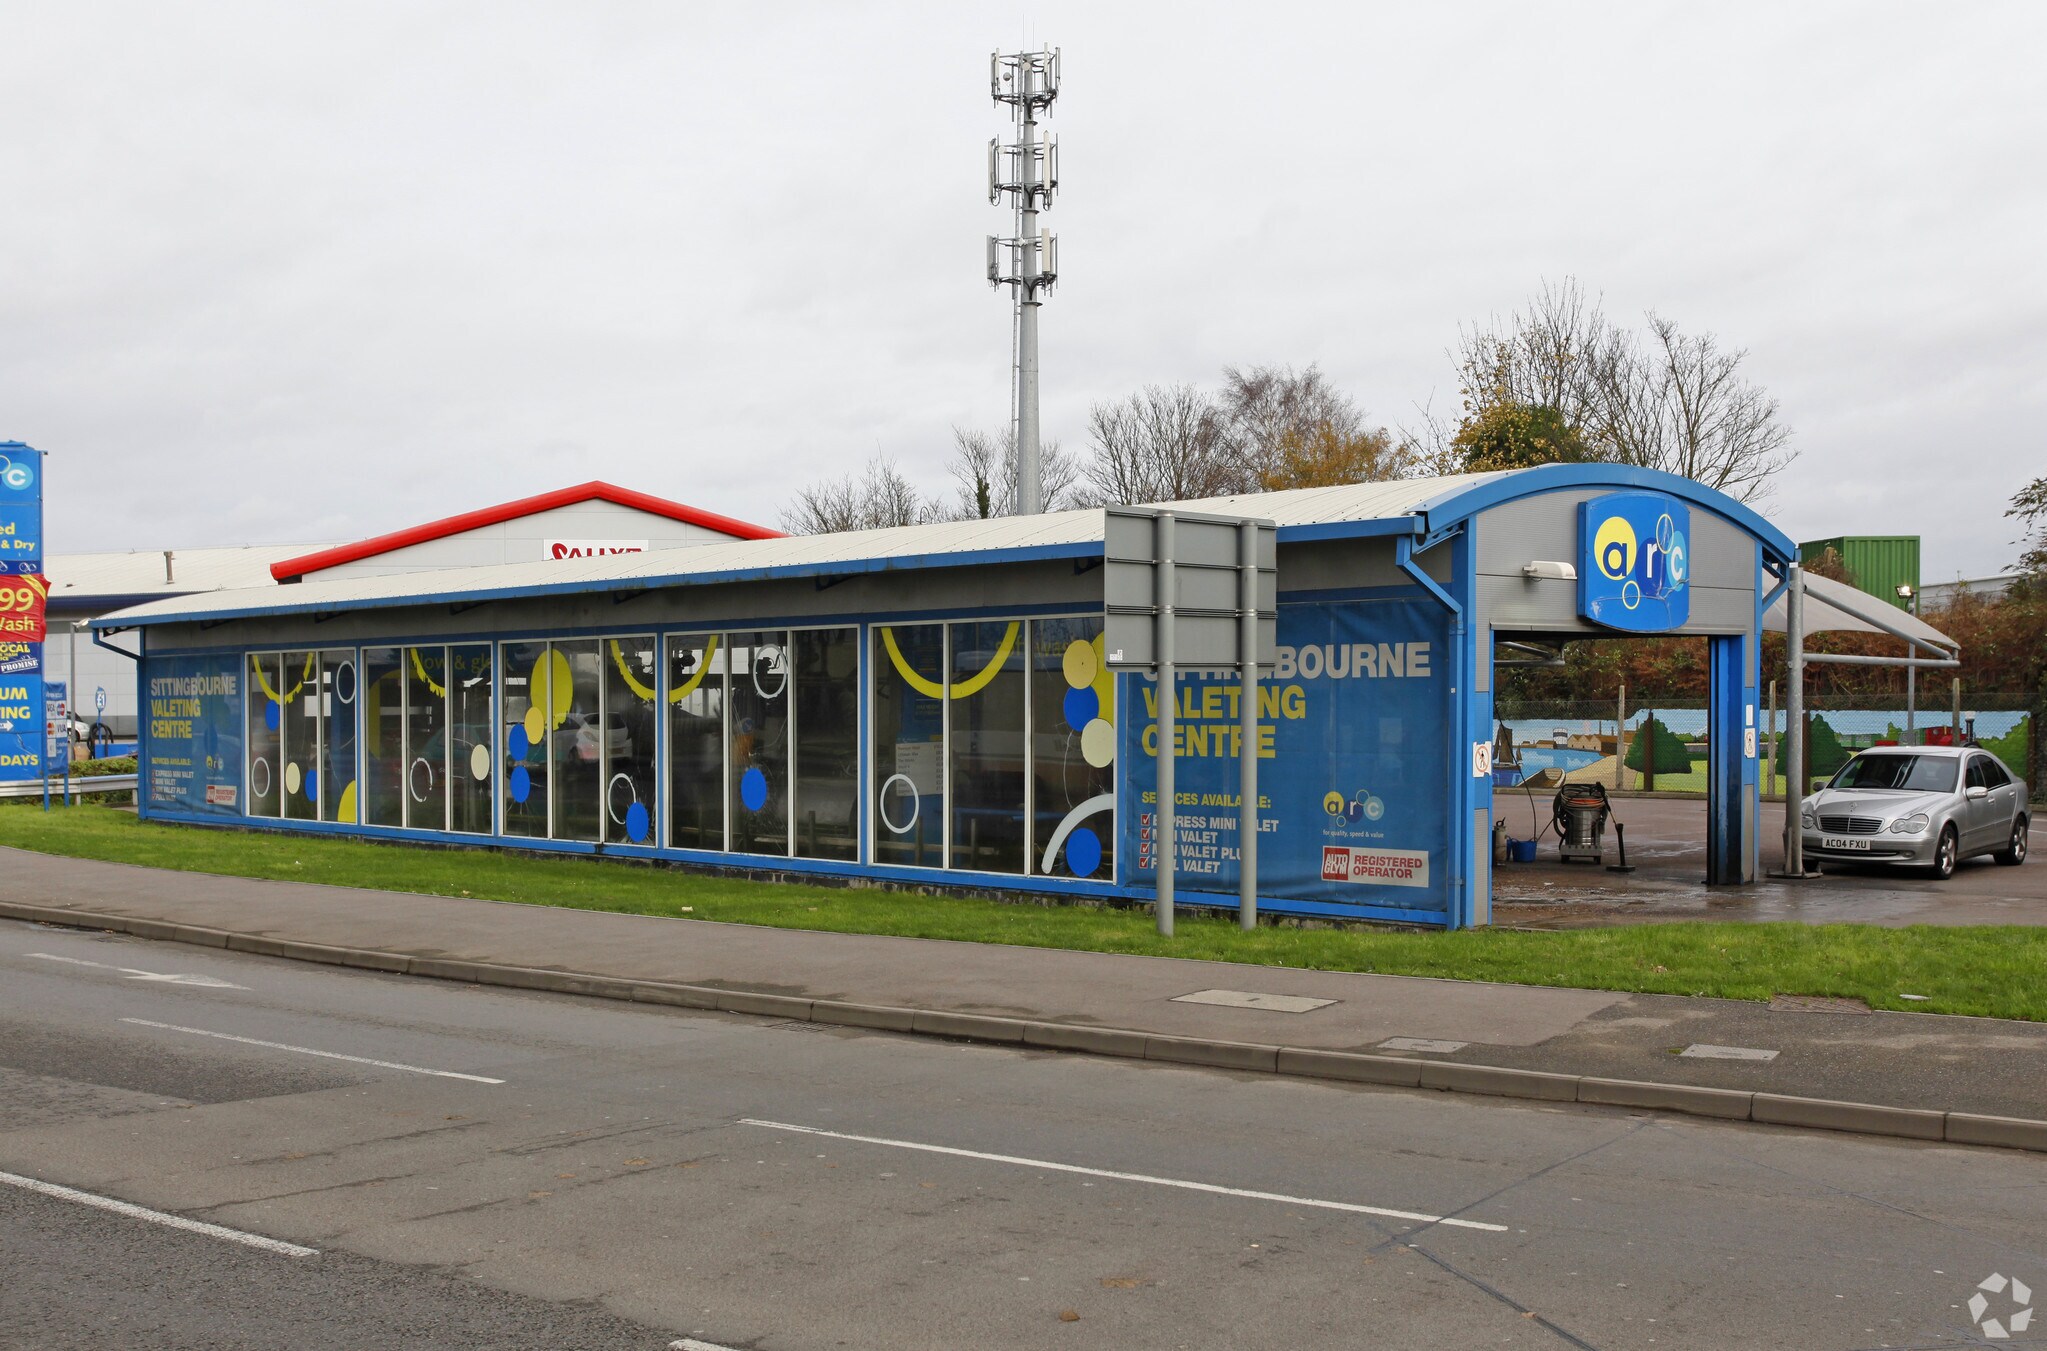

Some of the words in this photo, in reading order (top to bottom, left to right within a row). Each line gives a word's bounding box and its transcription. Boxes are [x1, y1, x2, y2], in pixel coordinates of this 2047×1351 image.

[14, 540, 36, 552] Dry
[1603, 540, 1684, 582] arc
[1, 660, 38, 672] PROMISE
[151, 676, 236, 696] SITTINGBOURNE
[151, 699, 201, 717] VALETING
[1142, 685, 1306, 719] VLETNG
[0, 706, 31, 719] ING
[151, 720, 192, 738] CENTRE
[0, 754, 39, 766] DAYS
[1142, 791, 1198, 805] SECES
[1201, 794, 1271, 808] AVAILAE:
[1152, 815, 1206, 828] EPRESS
[1209, 817, 1236, 830] MINI
[1181, 831, 1218, 844] VALET
[1825, 839, 1847, 848] AC04
[1849, 840, 1867, 848] FXU
[1181, 845, 1218, 858] VALET
[1221, 847, 1241, 861] PLU
[1326, 853, 1348, 864] AUTO
[1183, 860, 1220, 873] VALET
[1354, 855, 1423, 868] REGISTERED
[1324, 863, 1347, 875] GLYM
[1353, 866, 1413, 878] OPERATOR
